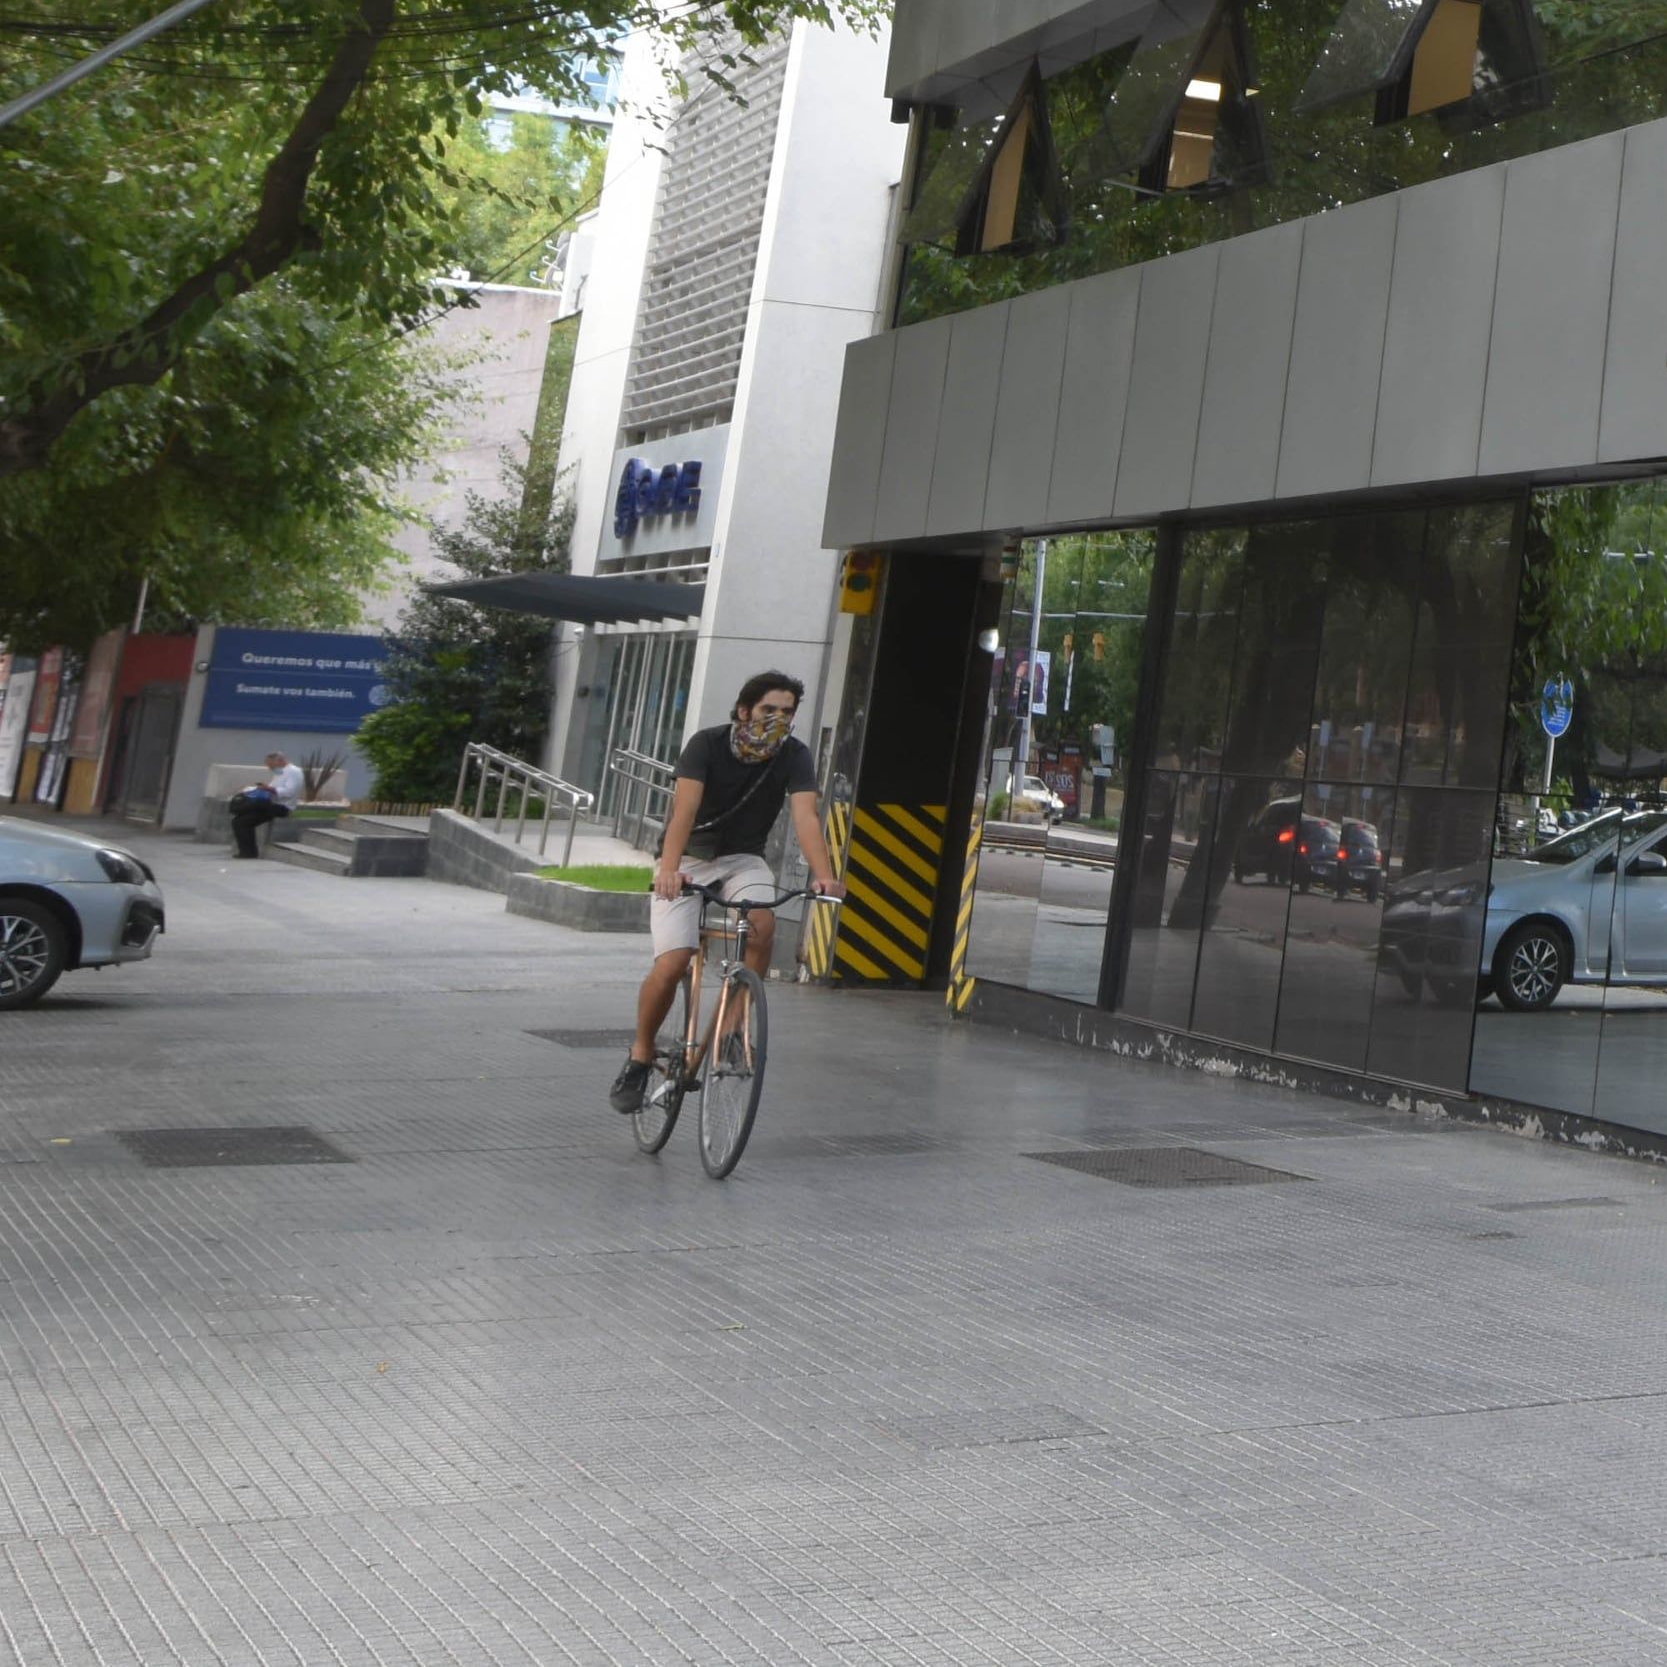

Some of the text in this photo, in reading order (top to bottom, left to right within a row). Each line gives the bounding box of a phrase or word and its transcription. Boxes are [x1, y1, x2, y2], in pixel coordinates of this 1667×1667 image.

[241, 652, 313, 667] Queremos
[315, 658, 342, 670] que
[344, 657, 370, 670] más
[236, 683, 356, 698] Sumate vos también.
